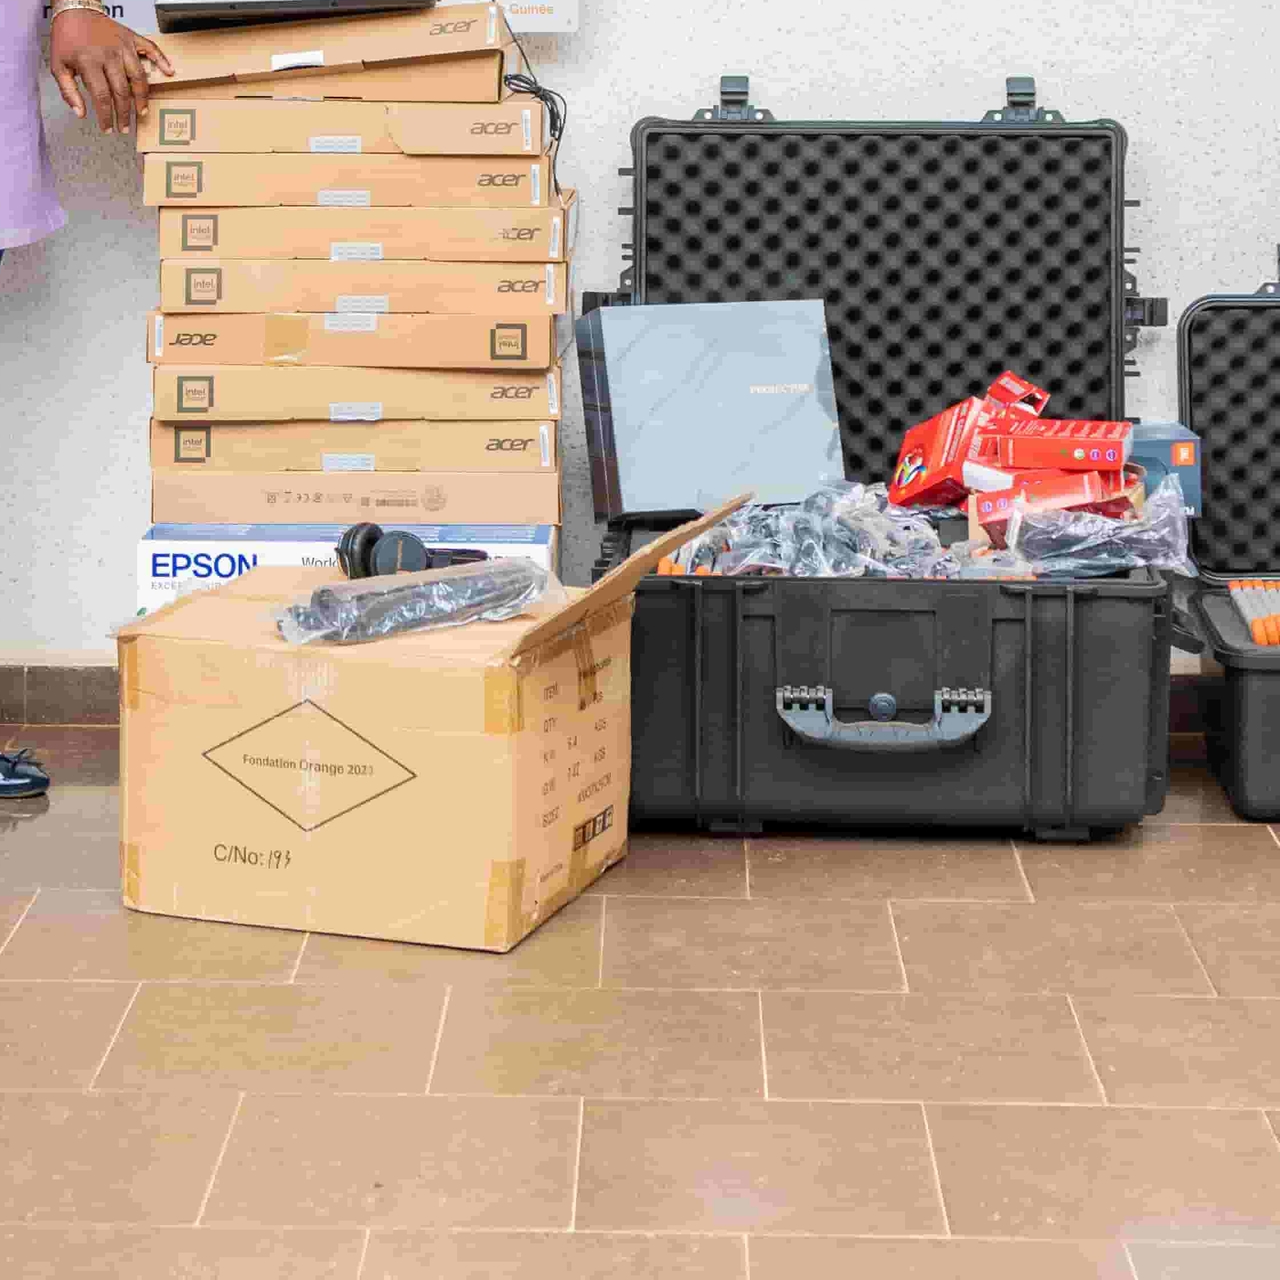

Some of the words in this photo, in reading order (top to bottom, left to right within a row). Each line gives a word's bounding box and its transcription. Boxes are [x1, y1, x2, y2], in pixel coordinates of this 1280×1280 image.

[430, 19, 478, 36] acer
[471, 122, 519, 135] acer
[477, 174, 526, 187] acer
[497, 280, 546, 293] acer
[490, 386, 540, 399] acer
[485, 438, 535, 451] acer
[152, 553, 257, 578] EPSON
[243, 754, 297, 769] Fondation
[299, 758, 345, 776] Orange
[214, 844, 264, 866] C/No:
